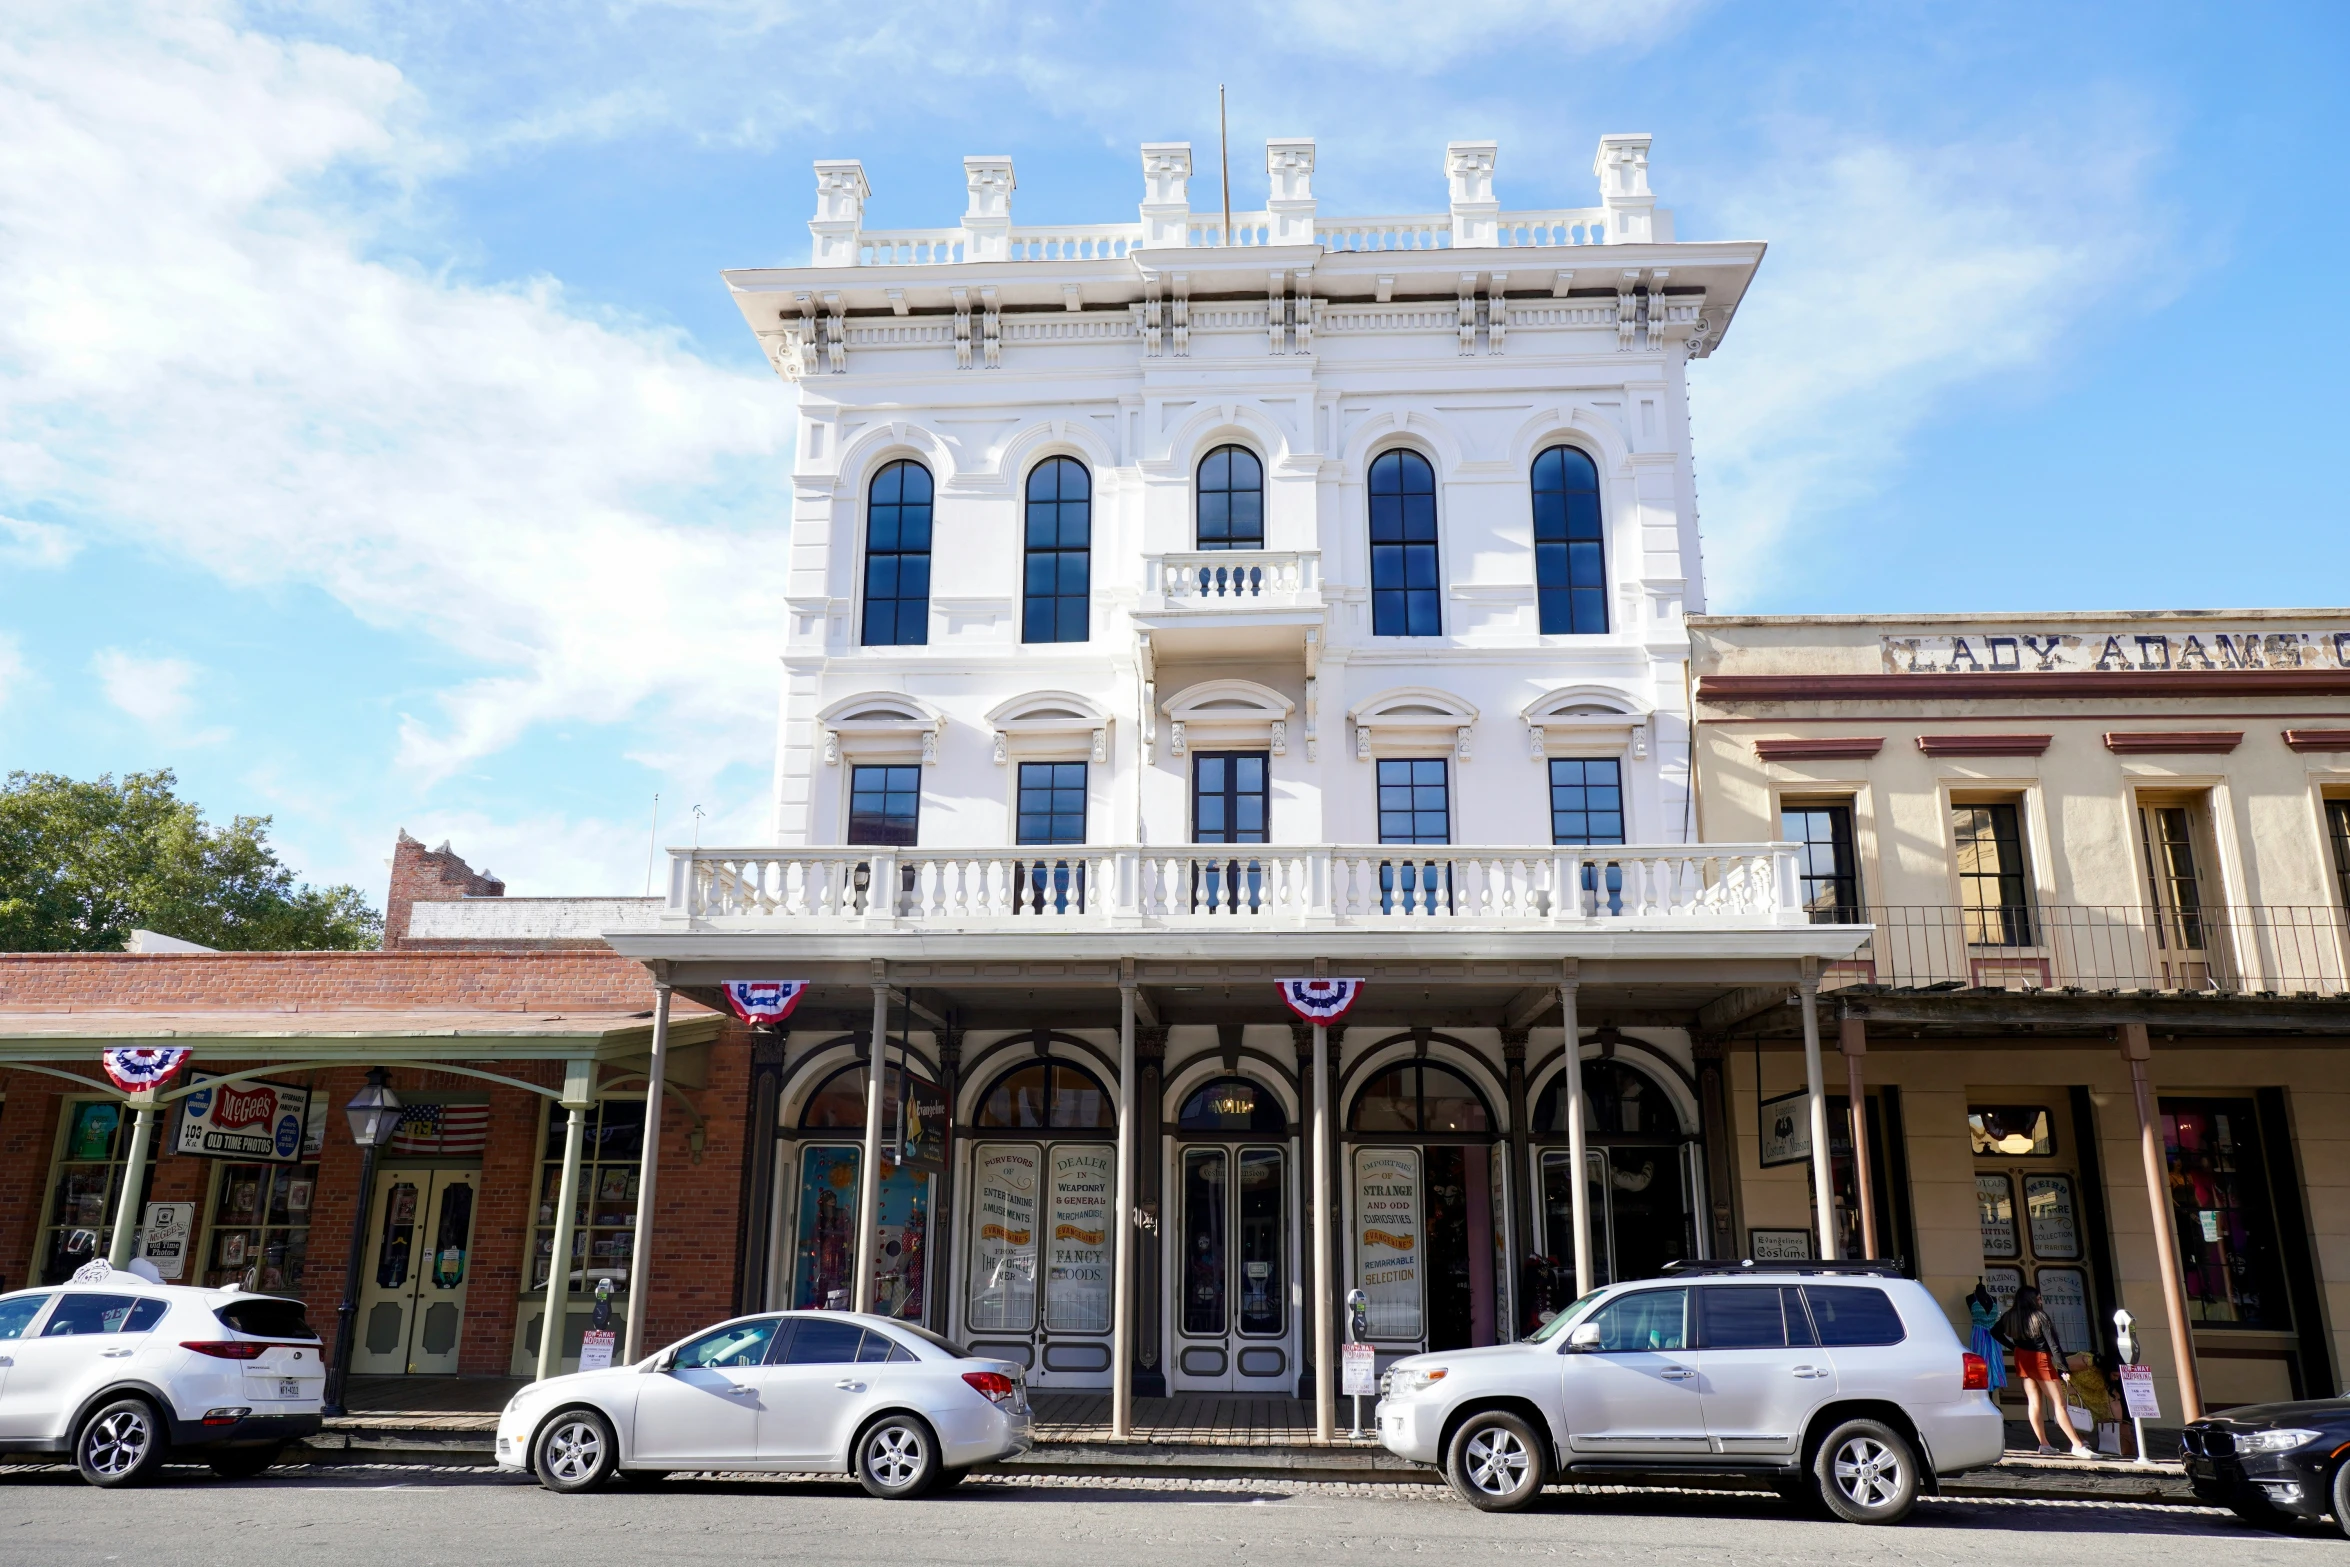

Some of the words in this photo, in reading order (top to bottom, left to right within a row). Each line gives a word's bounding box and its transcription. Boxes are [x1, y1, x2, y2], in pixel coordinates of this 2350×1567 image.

[1906, 635, 2060, 672] LADY
[281, 1093, 305, 1103] AFFORDABLE
[279, 1104, 293, 1112] FAMILY
[185, 1124, 203, 1139] 103
[185, 1138, 192, 1147] K
[207, 1134, 223, 1148] OLD
[224, 1135, 242, 1150] TIME
[242, 1137, 271, 1152] PHOTOS
[984, 1155, 1034, 1168] PURVEYORS
[1056, 1157, 1107, 1171] DEALER
[1362, 1159, 1412, 1172] IMPORTERS
[1381, 1172, 1394, 1180] OF
[1057, 1183, 1106, 1192] WEAPONRY
[1975, 1179, 2006, 1187] OTOUS
[2027, 1179, 2068, 1194] WEIRD
[983, 1187, 1033, 1207] ENTERTAINING
[1363, 1185, 1413, 1197] STRANGE
[1976, 1191, 2006, 1203] OYS
[1056, 1197, 1063, 1205] &
[1064, 1196, 1106, 1205] GENERAL
[1367, 1201, 1387, 1209] AND
[1389, 1201, 1410, 1209] ODD
[983, 1203, 1032, 1223] AMUSEMENTS.
[2038, 1223, 2045, 1231] A
[983, 1226, 1029, 1243] EVANGELINE'S
[1057, 1226, 1103, 1243] EVANGELINE'S
[1365, 1231, 1413, 1249] EVANGELINE'S
[2034, 1231, 2073, 1241] COLLECTION
[1757, 1236, 1804, 1247] Evangeline's
[1983, 1238, 2013, 1250] AGS
[1056, 1250, 1104, 1264] FANCY
[1757, 1246, 1806, 1259] Costume
[982, 1253, 996, 1272] THE
[999, 1254, 1028, 1273] ORLD
[1365, 1255, 1415, 1270] REMARKABLE
[999, 1271, 1016, 1280] VER
[1064, 1268, 1103, 1281] OODS.
[1365, 1269, 1414, 1286] SELECTION
[2040, 1276, 2081, 1289] UNUSUAL
[2057, 1285, 2065, 1293] &
[2042, 1295, 2082, 1306] WITTY
[583, 1336, 594, 1344] NO
[585, 1330, 615, 1338] TOW-AWAY
